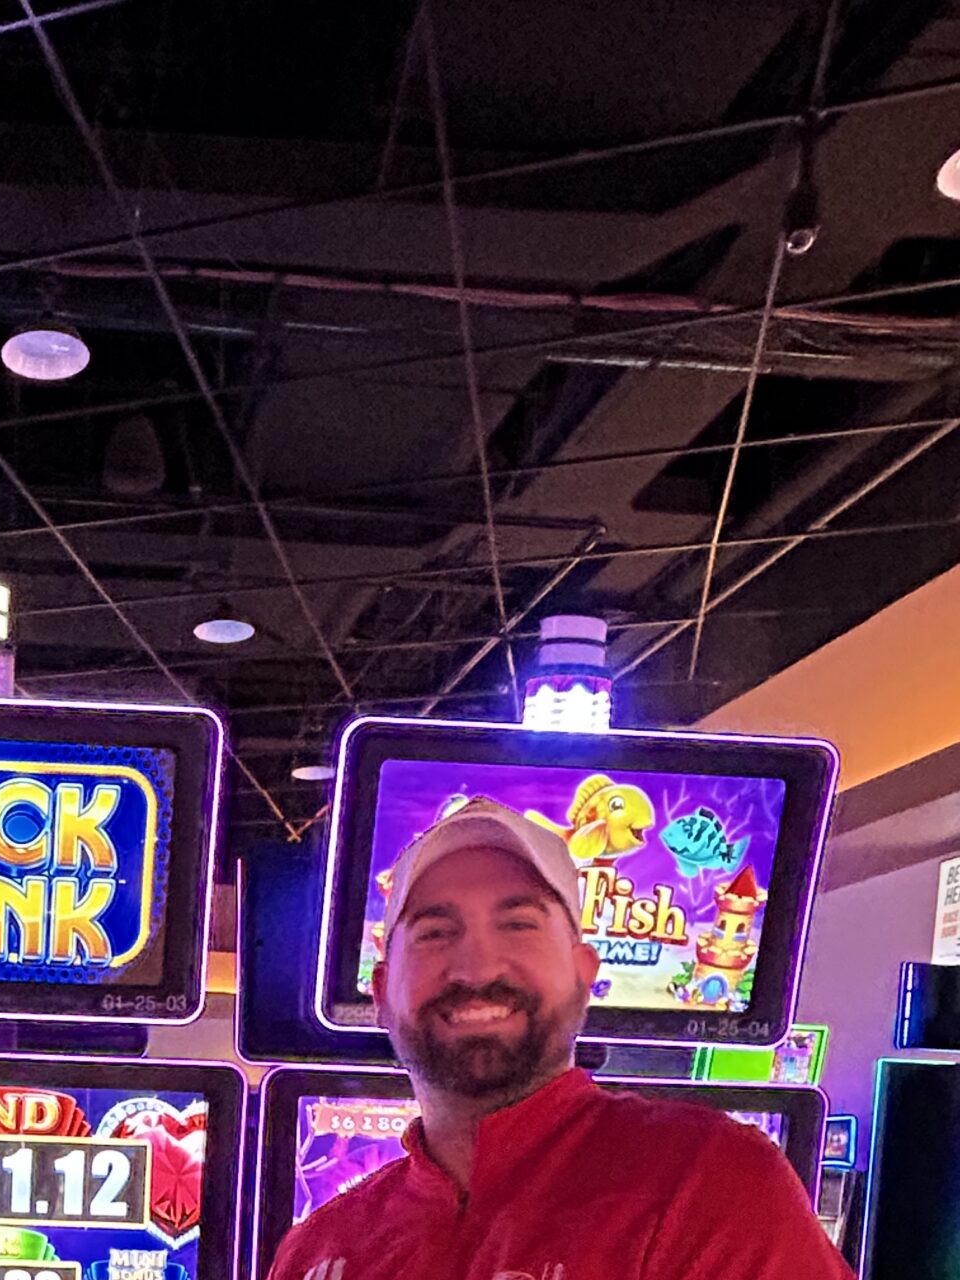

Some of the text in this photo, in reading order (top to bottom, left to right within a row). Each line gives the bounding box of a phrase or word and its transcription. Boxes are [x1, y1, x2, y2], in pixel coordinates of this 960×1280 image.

[578, 866, 689, 946] Fish
[686, 1019, 770, 1038] 01-25-04
[108, 1247, 168, 1268] MINI
